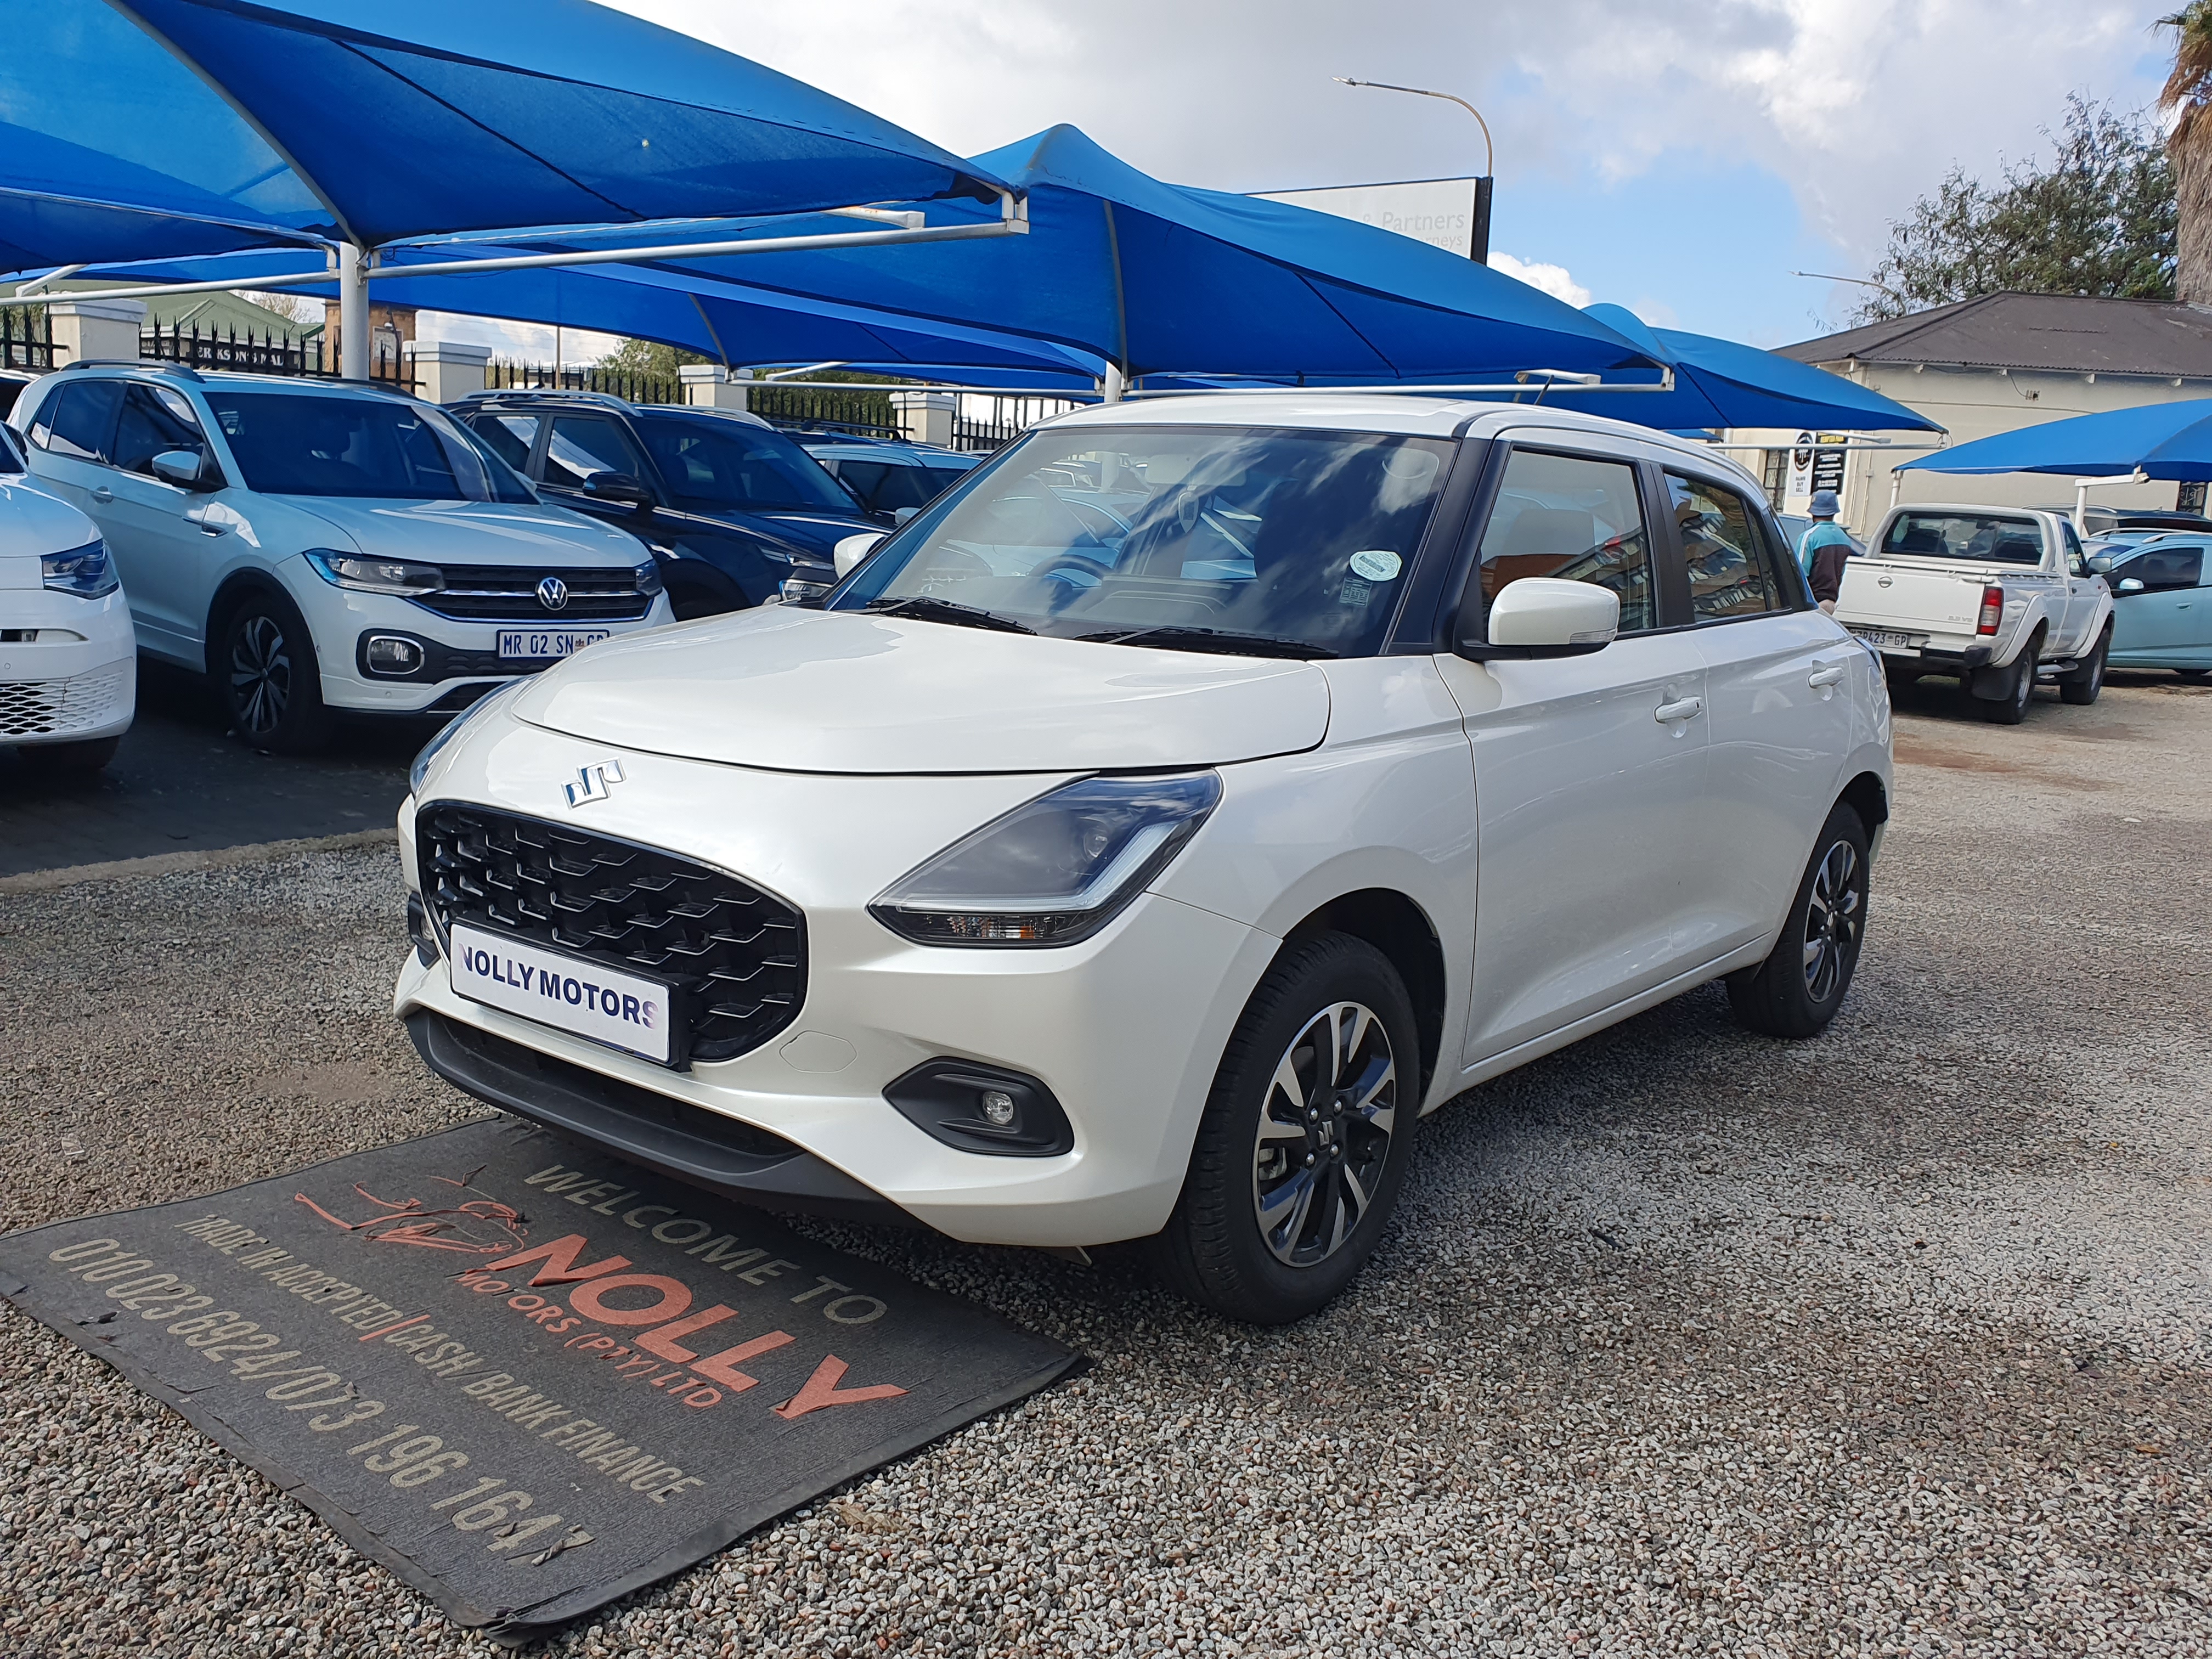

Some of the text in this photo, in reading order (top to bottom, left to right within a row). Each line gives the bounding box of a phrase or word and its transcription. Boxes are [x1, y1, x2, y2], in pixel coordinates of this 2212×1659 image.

[1382, 211, 1465, 232] Partners
[504, 635, 522, 654] MR
[531, 635, 548, 654] 02
[556, 635, 573, 654] SN
[1894, 634, 1906, 646] GP
[459, 943, 658, 1029] NOLLY MOTORS
[524, 1164, 888, 1324] WELCOME TO
[48, 1238, 154, 1282] 010
[105, 1273, 214, 1320] 023
[346, 1423, 470, 1488] 196
[237, 1246, 295, 1269] IN
[540, 1418, 706, 1503] FINANCE
[454, 1268, 582, 1333] MOORS
[650, 1371, 723, 1407] LTD
[485, 1233, 910, 1419] NOLLY
